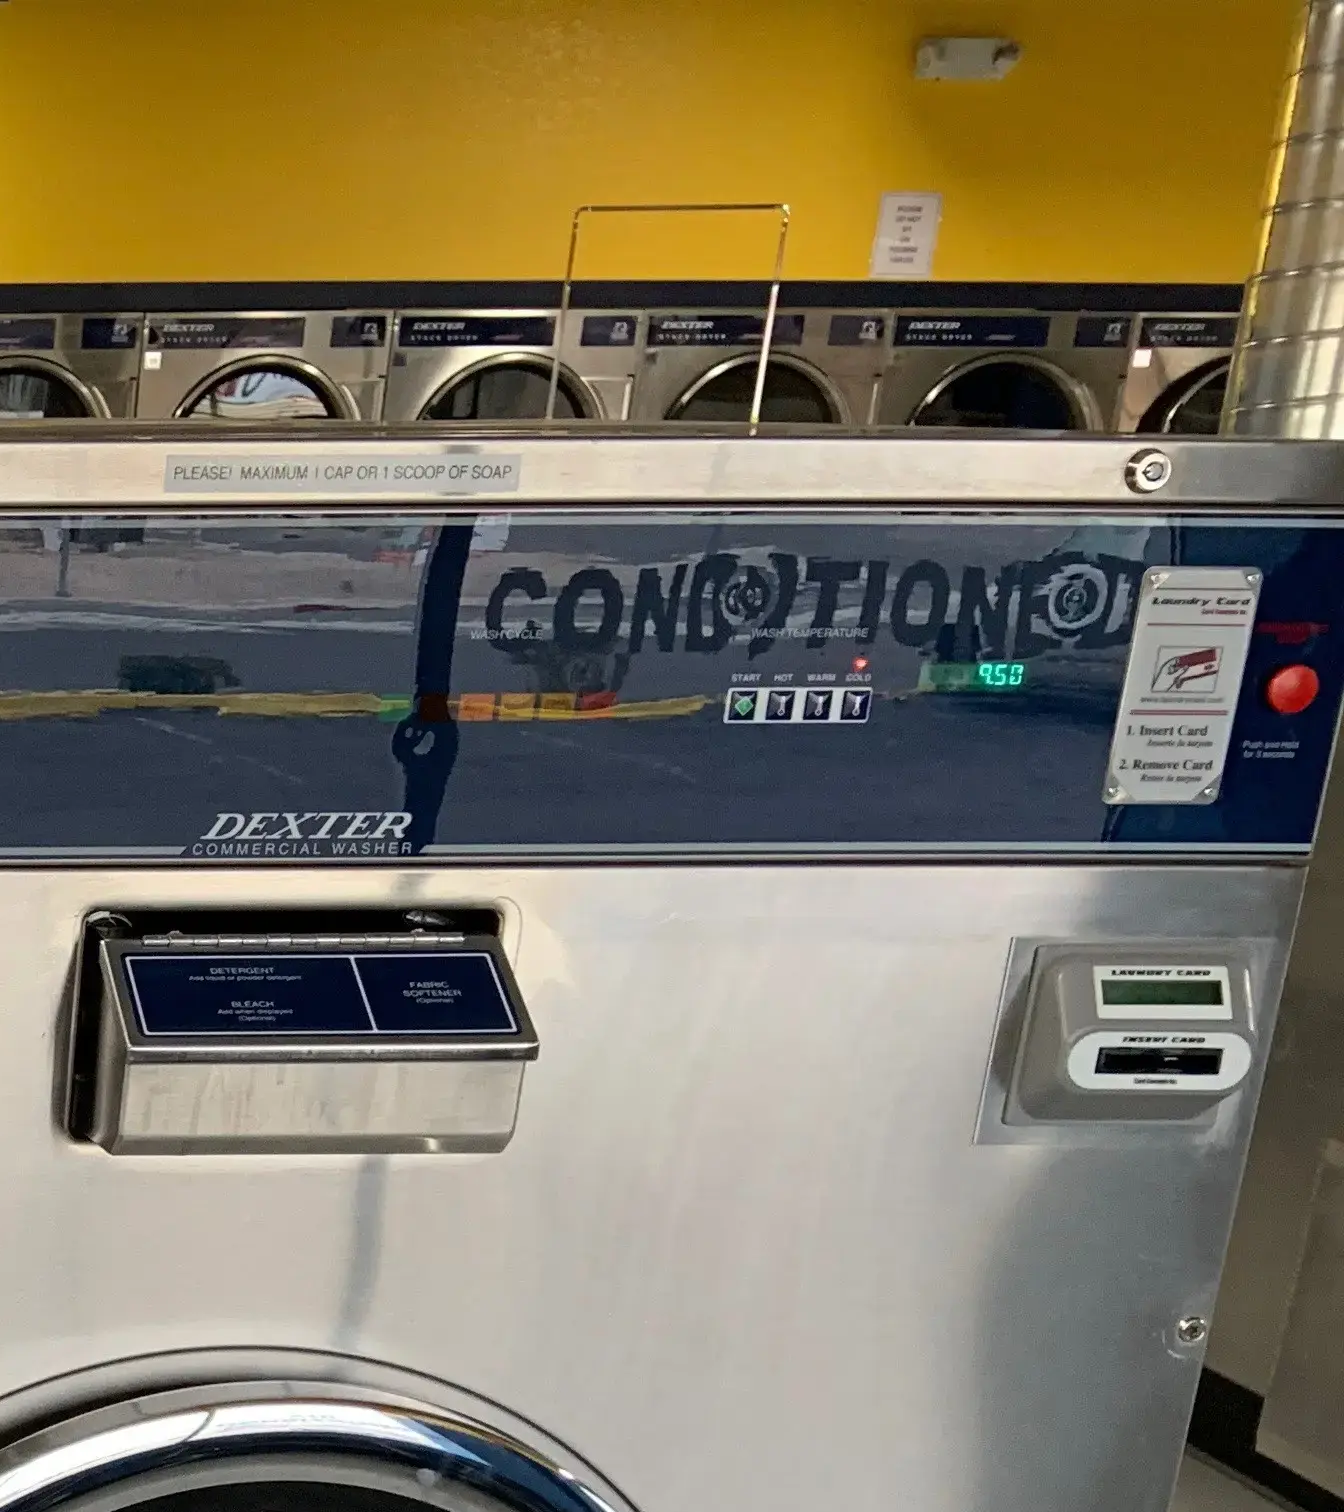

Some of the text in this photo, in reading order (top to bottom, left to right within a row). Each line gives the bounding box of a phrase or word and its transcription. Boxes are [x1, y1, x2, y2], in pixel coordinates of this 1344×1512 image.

[173, 466, 231, 480] PLEASE!
[240, 466, 308, 480] MAXIMUM
[324, 466, 353, 480] CAP
[356, 466, 379, 480] OR
[393, 466, 445, 480] SCOOP
[448, 466, 469, 480] OF
[471, 466, 512, 480] SOAP
[1151, 597, 1252, 606] Laundry Card
[471, 630, 543, 640] WASH CYCLE
[1140, 726, 1175, 736] Insert
[1177, 726, 1208, 736] Card
[1132, 760, 1180, 770] Remove
[1182, 760, 1213, 770] Card
[201, 812, 412, 840] DEXTER
[192, 841, 412, 855] COMMERCIAL WASHER
[210, 967, 274, 975] DETERGENT
[409, 981, 449, 989] FABRIC
[403, 989, 462, 997] SOFTENER
[231, 1000, 274, 1008] BLEACH
